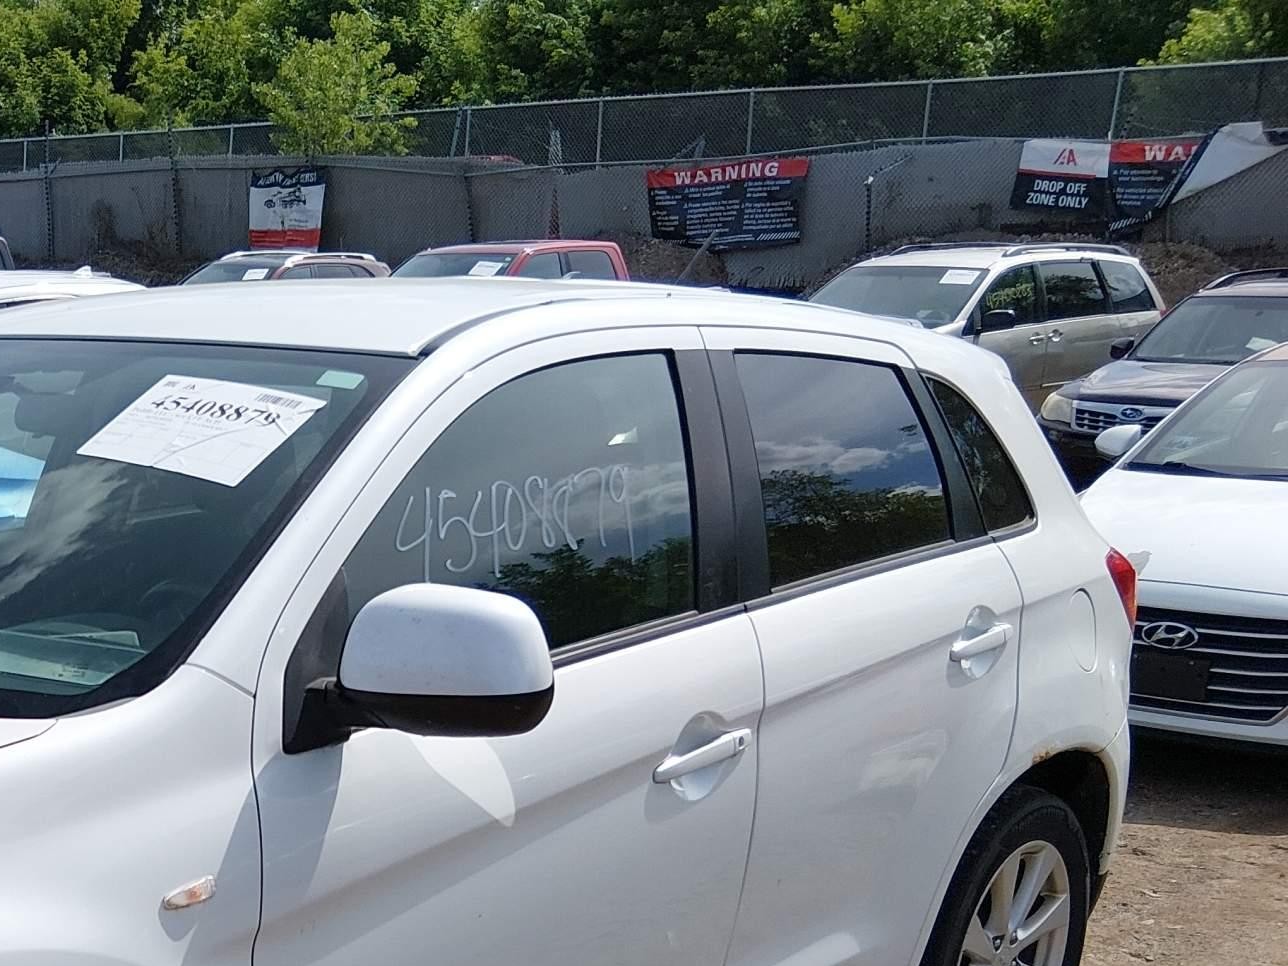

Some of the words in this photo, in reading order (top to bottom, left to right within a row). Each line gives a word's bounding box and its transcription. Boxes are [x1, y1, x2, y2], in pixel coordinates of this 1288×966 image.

[1144, 144, 1199, 161] WA
[674, 162, 779, 185] WARNING
[1033, 179, 1064, 193] DROP
[1066, 182, 1087, 195] OFF
[1026, 191, 1057, 206] ZONE
[1058, 195, 1089, 209] ONLY
[152, 394, 281, 427] 45408879
[395, 464, 636, 583] 45408879
